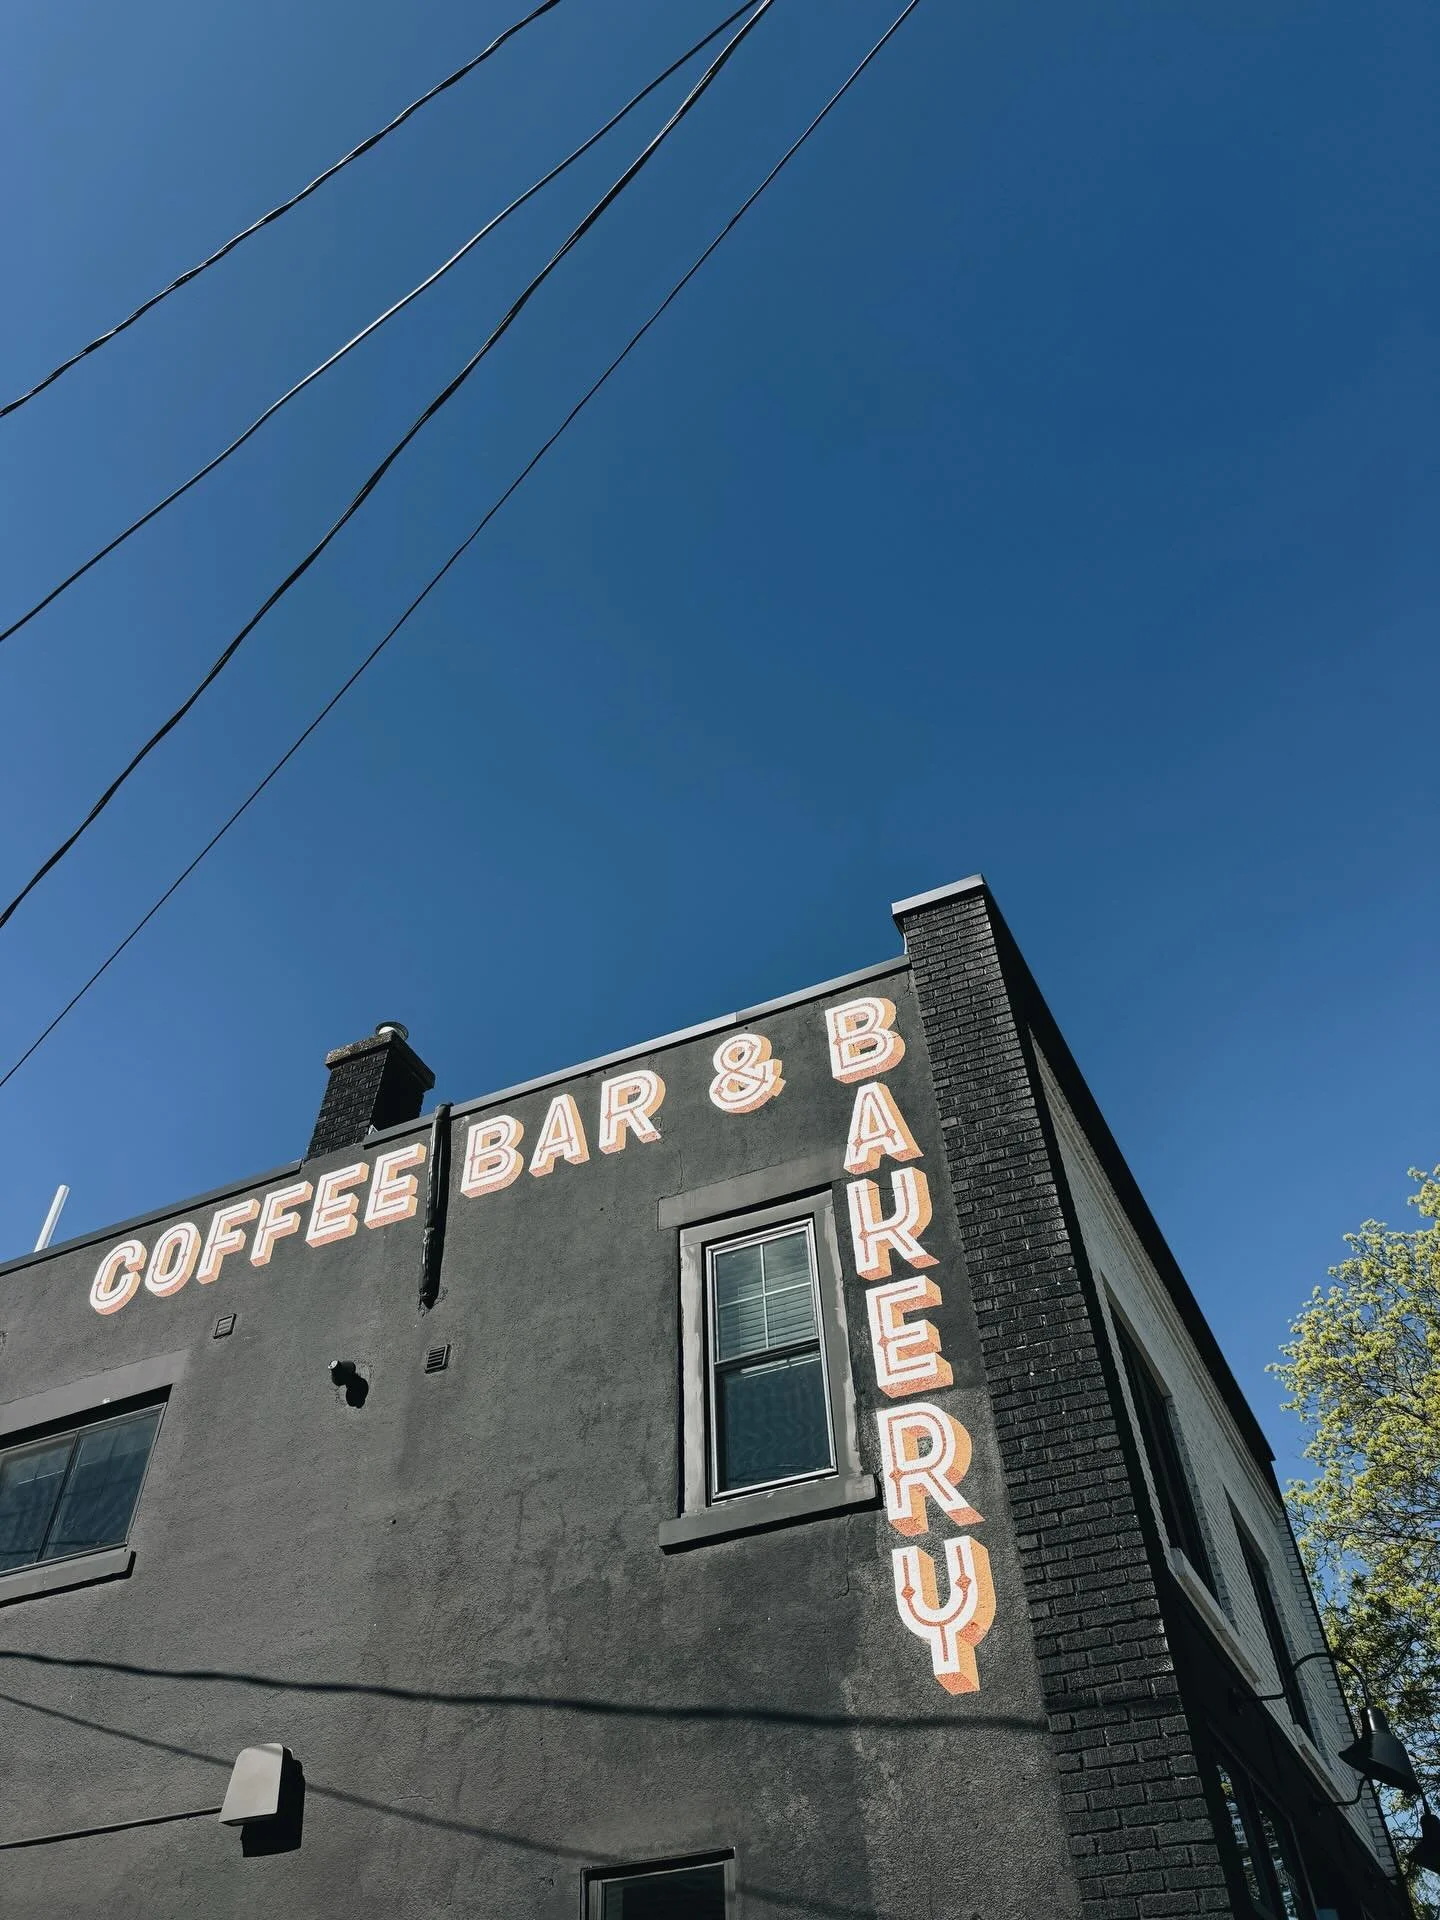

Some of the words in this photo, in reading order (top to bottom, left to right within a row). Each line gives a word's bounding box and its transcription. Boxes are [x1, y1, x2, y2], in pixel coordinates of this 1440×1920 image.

[89, 1142, 427, 1315] COFFEE
[459, 1069, 665, 1198] BAR
[709, 1032, 786, 1114] &
[825, 996, 997, 1695] BAKERY
